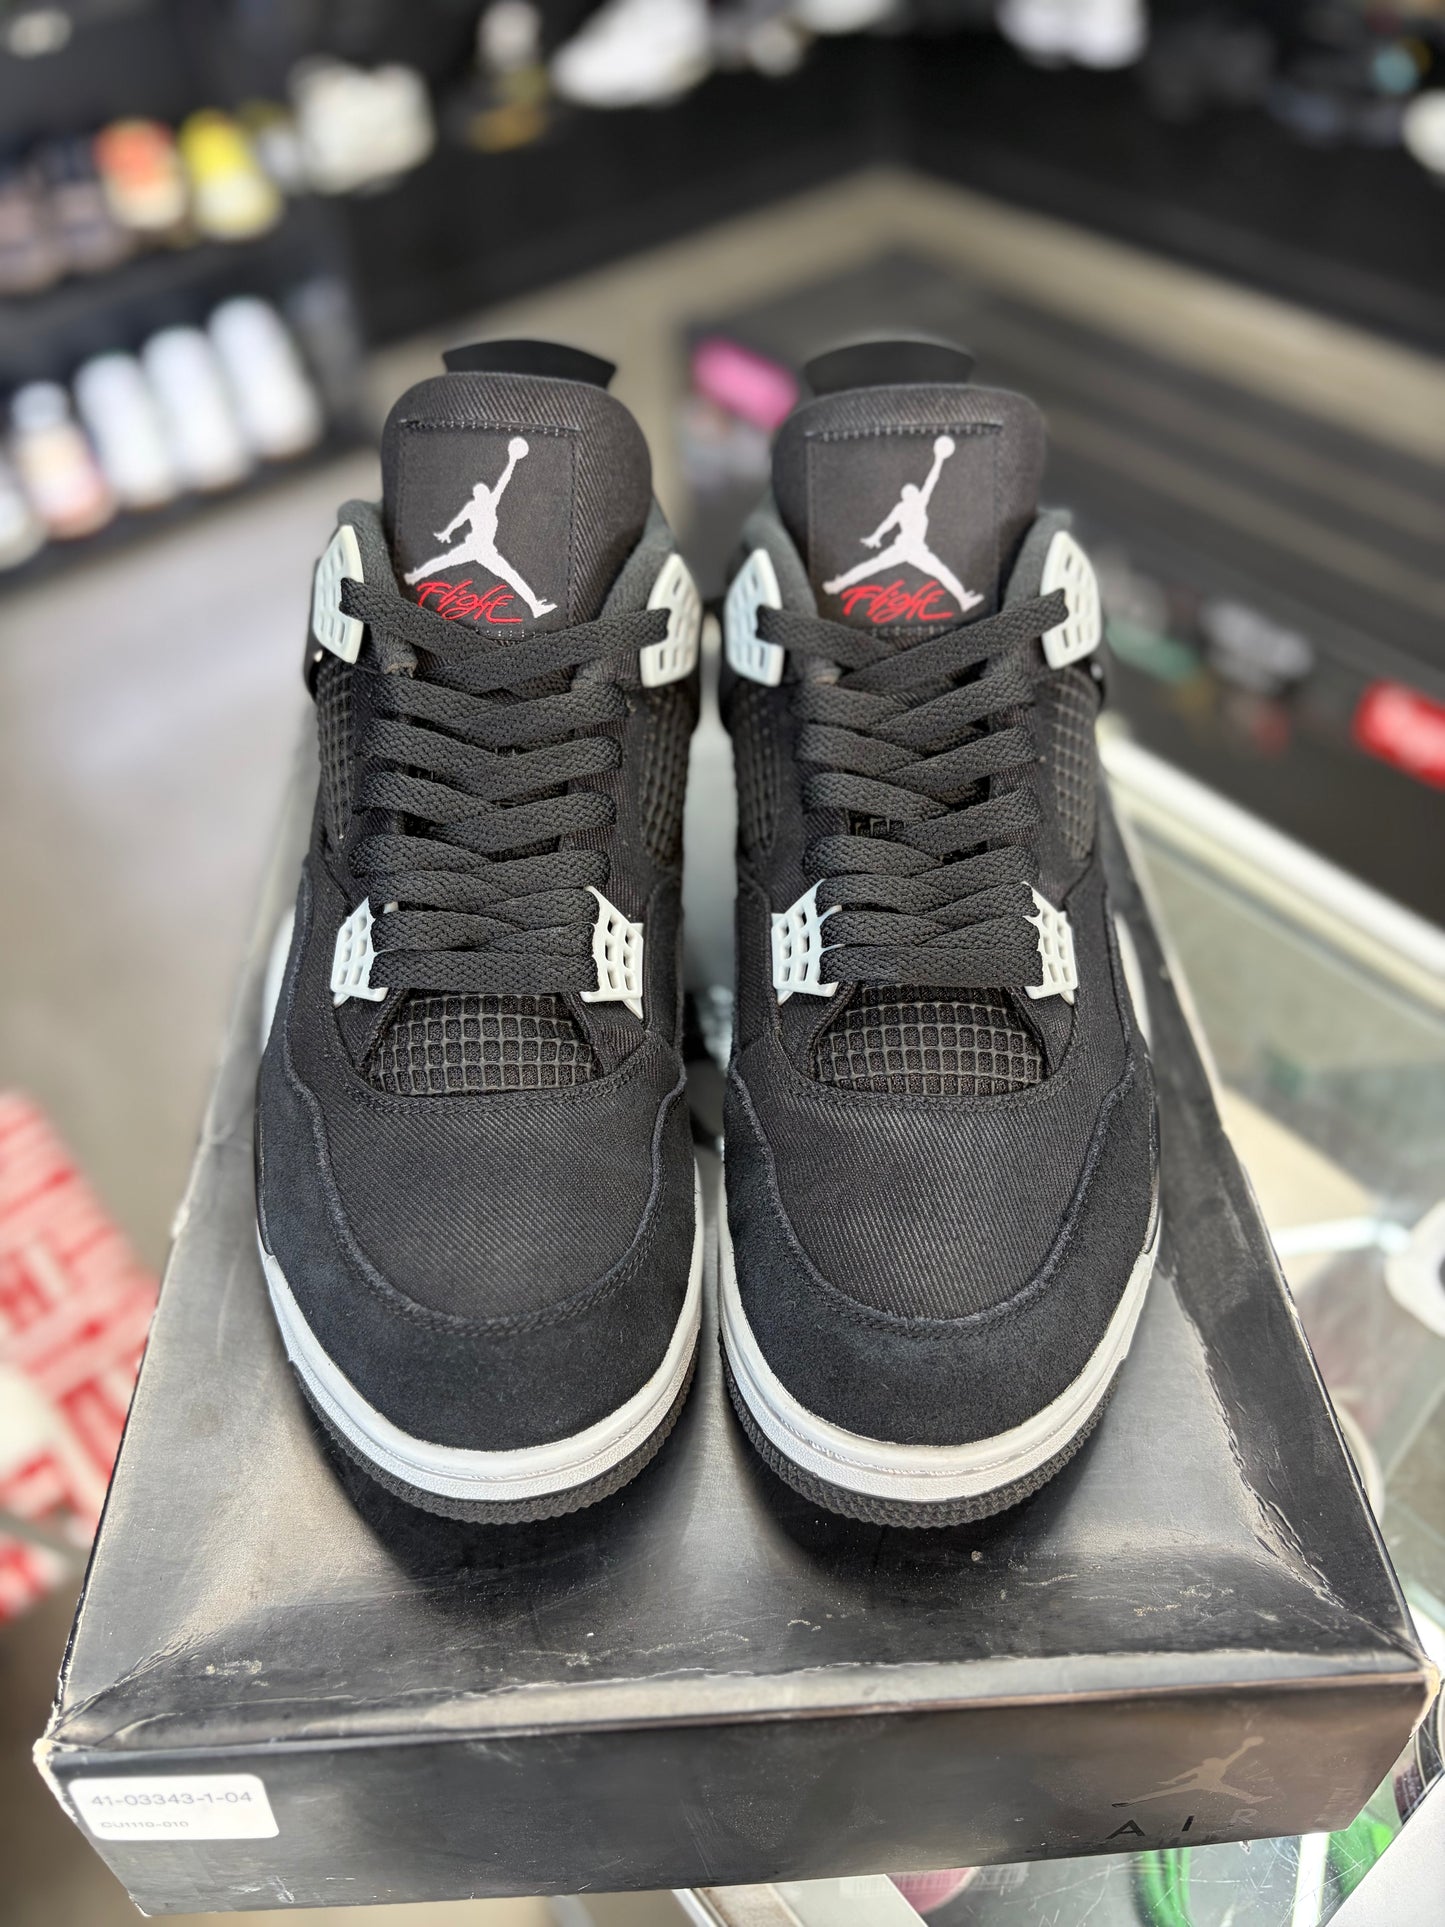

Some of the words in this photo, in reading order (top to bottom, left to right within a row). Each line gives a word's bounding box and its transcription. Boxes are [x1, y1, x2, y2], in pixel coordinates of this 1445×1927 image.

[417, 578, 523, 624] Flight
[840, 579, 954, 624] Flight
[91, 1791, 253, 1807] 41-03343-1-04
